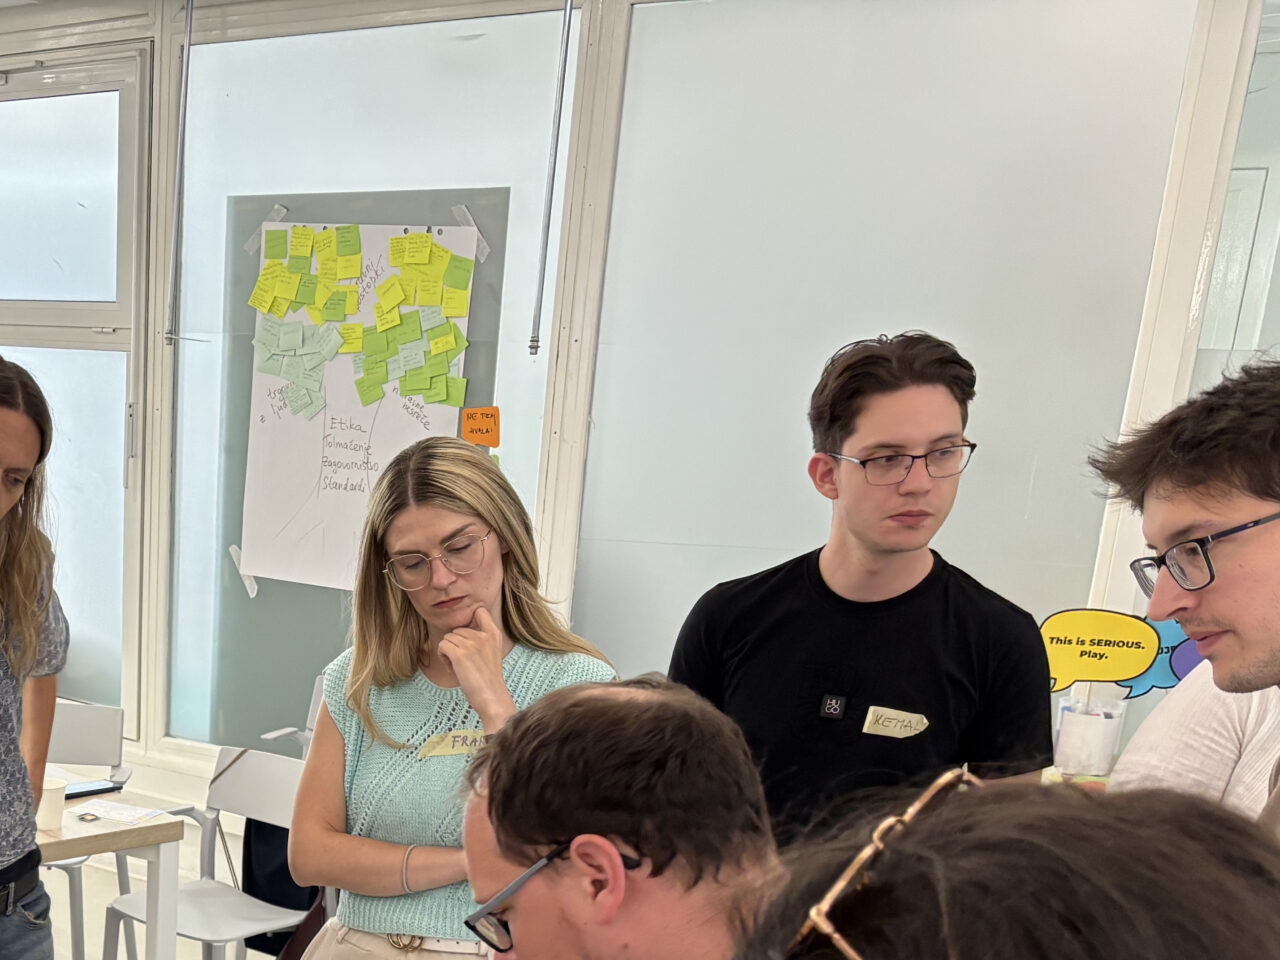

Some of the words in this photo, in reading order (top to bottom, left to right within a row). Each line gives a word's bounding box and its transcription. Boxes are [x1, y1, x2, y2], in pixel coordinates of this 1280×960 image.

[330, 416, 367, 433] Etika
[1049, 636, 1073, 646] This
[1076, 636, 1086, 646] is
[1089, 638, 1146, 650] SERIOUS.
[1079, 650, 1108, 660] Play.
